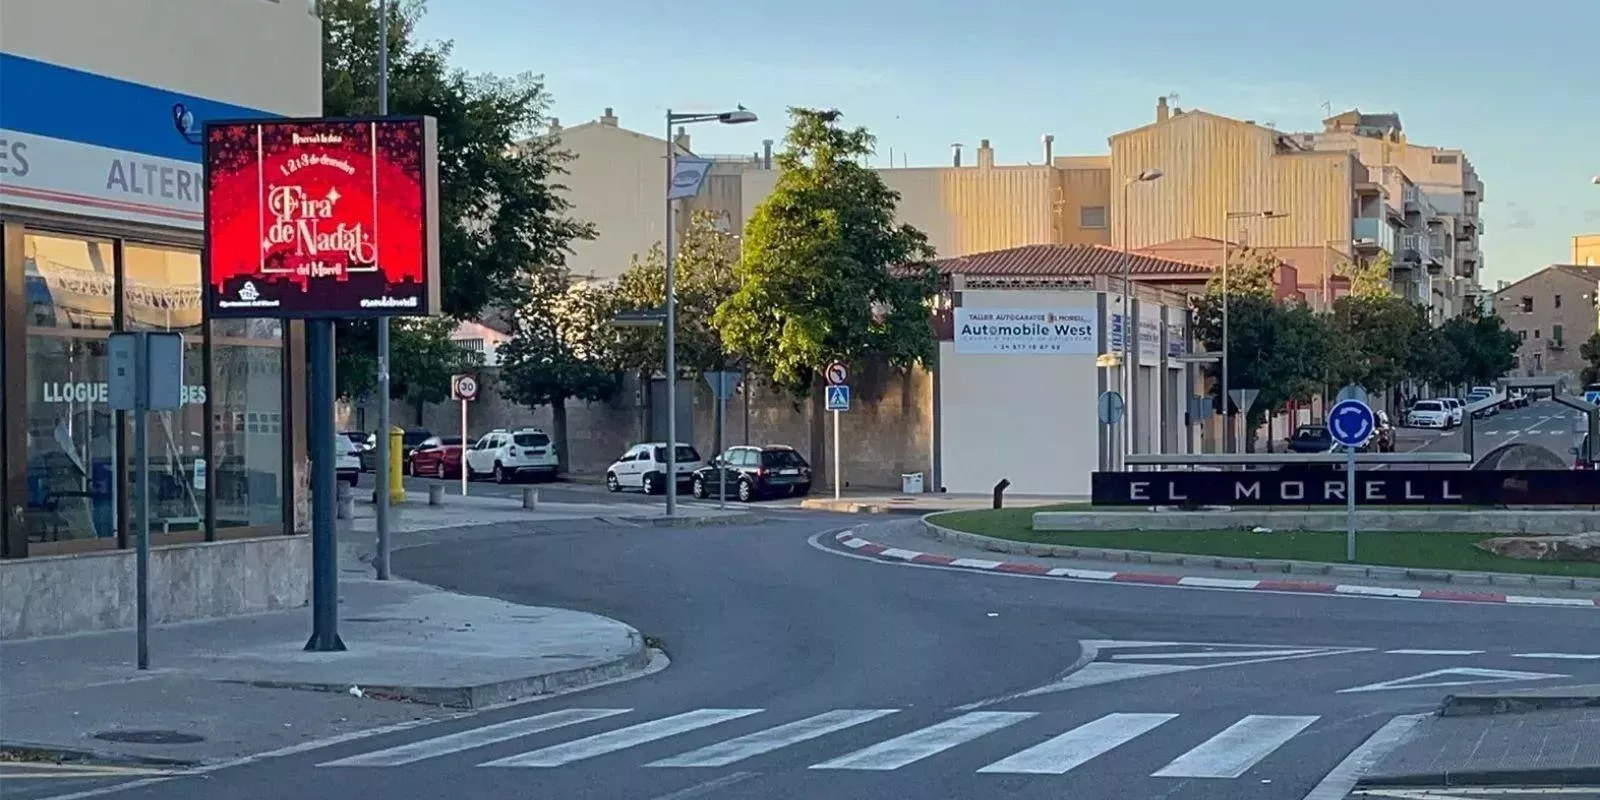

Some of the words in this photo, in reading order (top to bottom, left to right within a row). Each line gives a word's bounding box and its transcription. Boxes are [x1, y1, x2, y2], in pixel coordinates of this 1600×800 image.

[287, 159, 298, 173] 2
[300, 153, 309, 167] 3
[268, 185, 333, 221] Fira
[269, 219, 295, 244] de
[295, 218, 377, 264] Nadal
[296, 261, 310, 276] del
[311, 261, 342, 278] Morell
[968, 314, 993, 322] TALLER
[961, 323, 1050, 336] Automobile
[1055, 324, 1092, 336] West
[461, 382, 474, 391] 30
[1129, 481, 1187, 501] EL
[1235, 481, 1463, 501] MORELL
